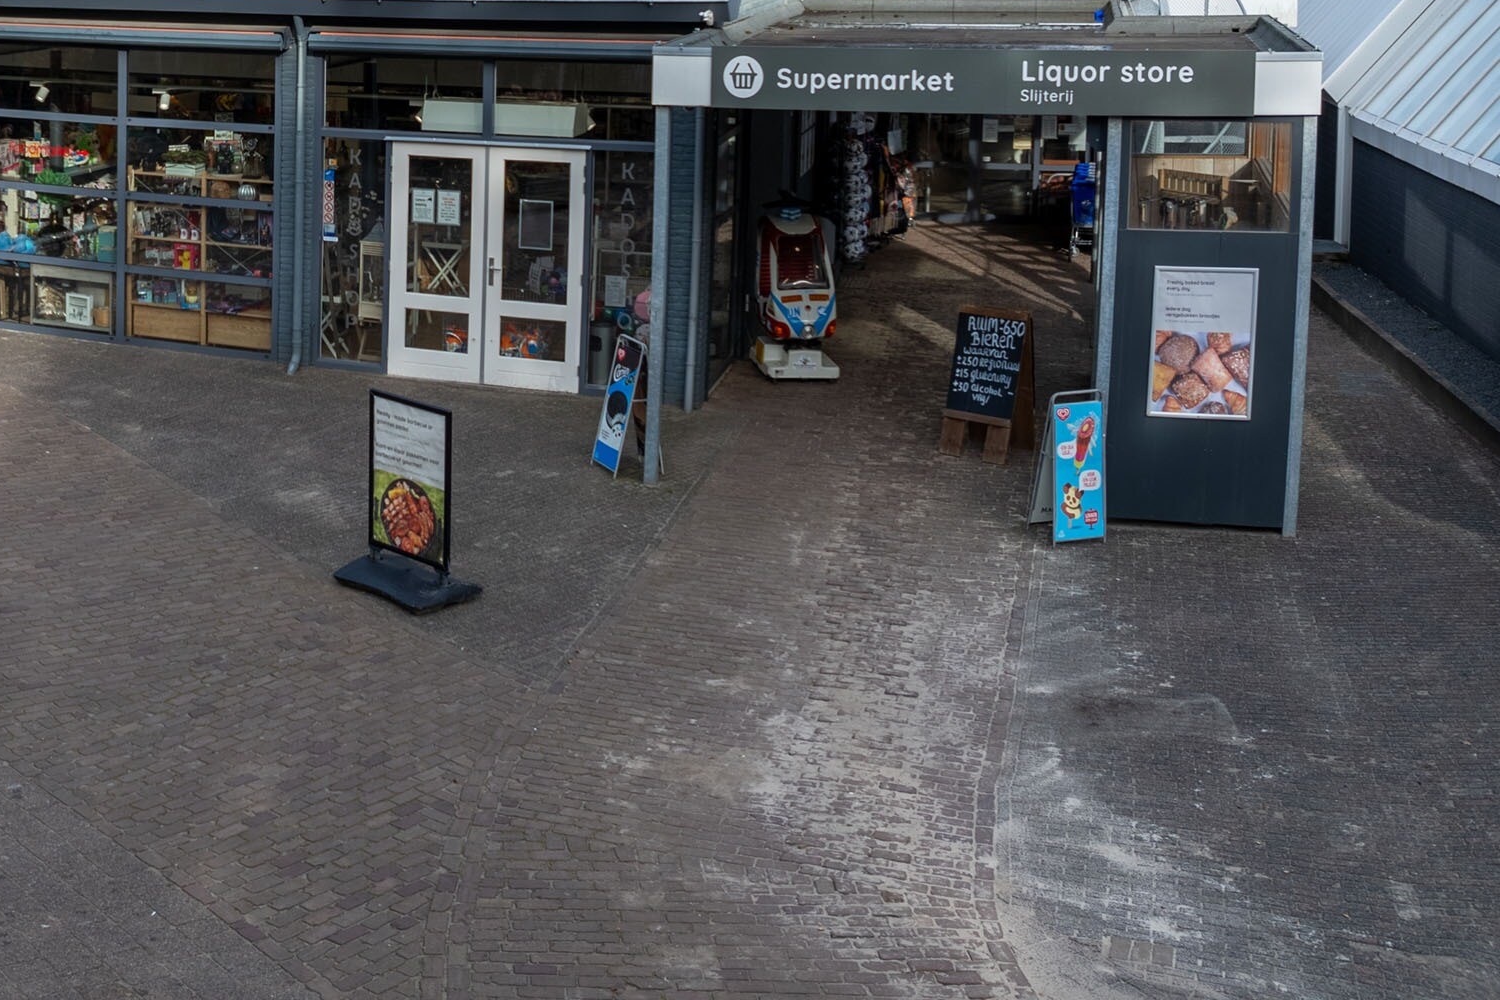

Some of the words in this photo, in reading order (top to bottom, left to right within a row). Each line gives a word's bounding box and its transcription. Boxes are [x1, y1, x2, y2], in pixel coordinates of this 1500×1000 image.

[776, 67, 955, 94] Supermarket
[1021, 60, 1110, 87] Liquor
[1120, 63, 1195, 84] store
[1020, 88, 1074, 106] Slijterij
